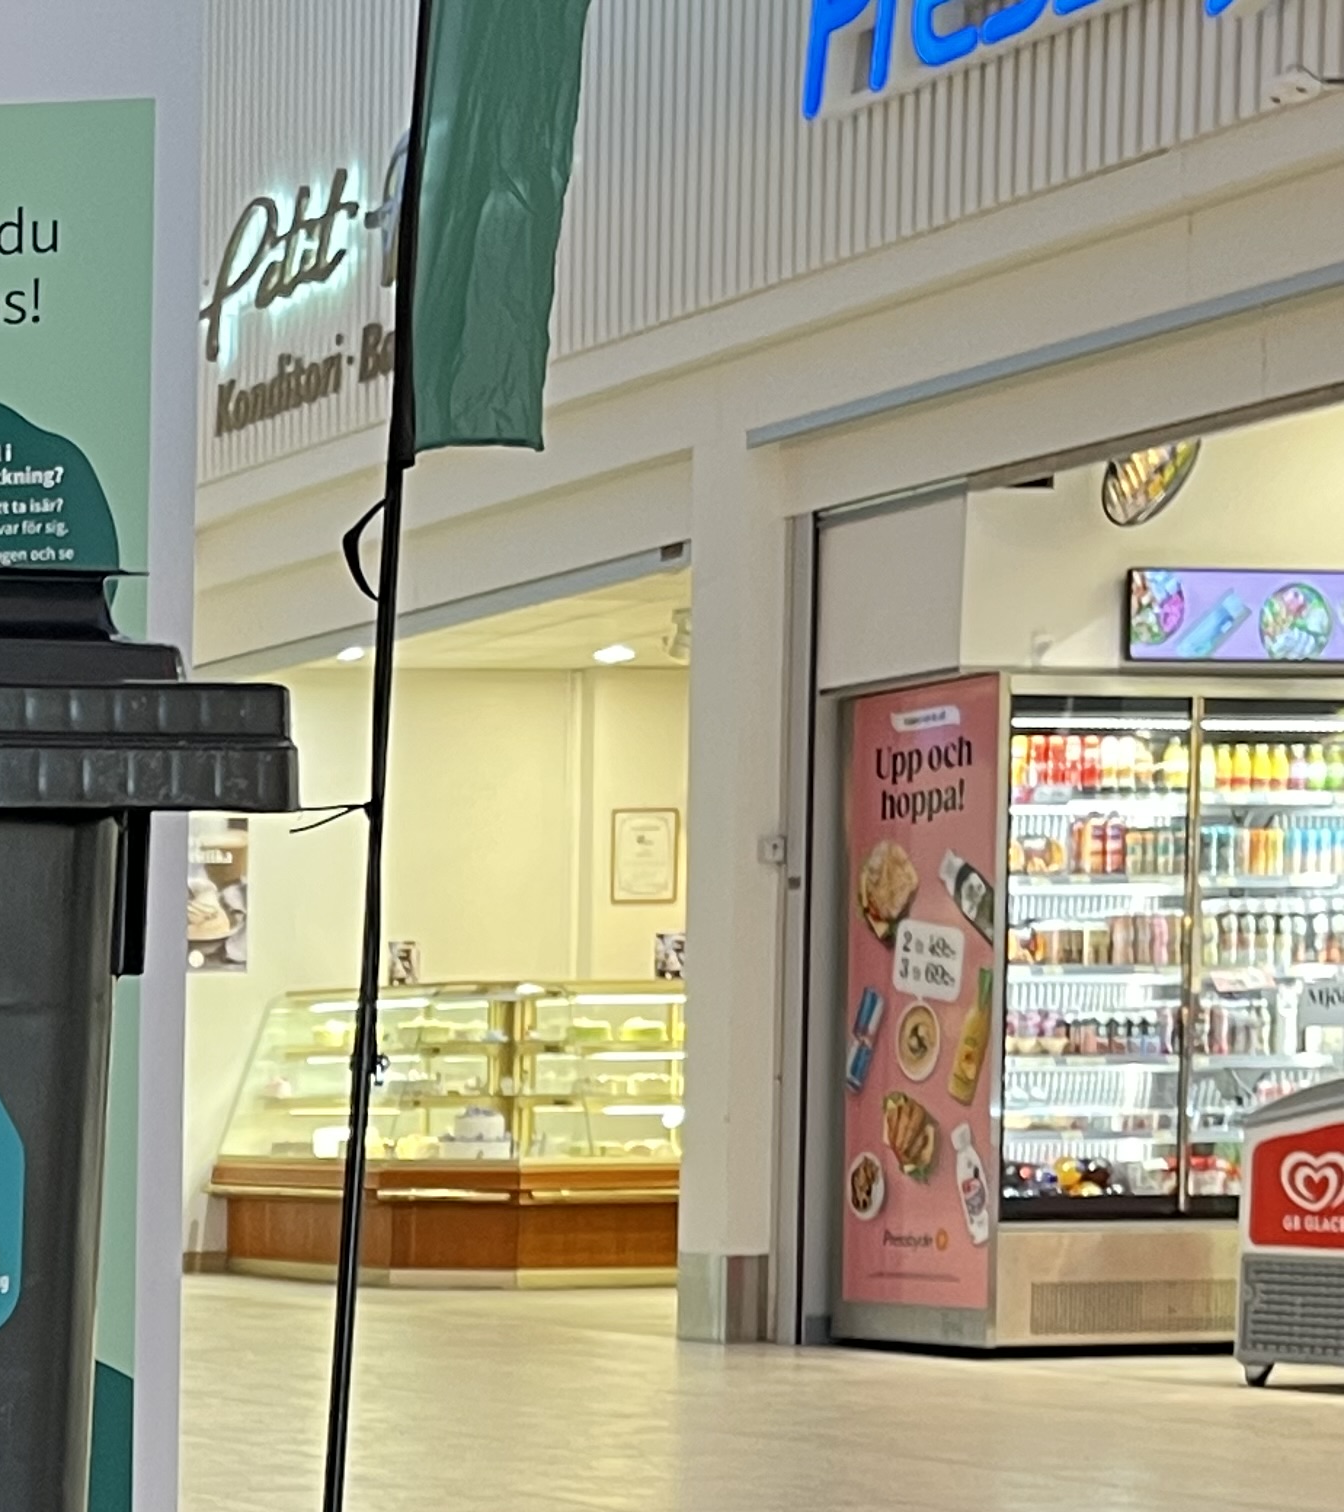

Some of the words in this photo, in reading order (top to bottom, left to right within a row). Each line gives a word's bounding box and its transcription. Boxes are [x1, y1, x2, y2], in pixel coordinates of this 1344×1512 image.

[216, 334, 342, 437] Konditori
[5, 444, 12, 462] i
[12, 500, 27, 514] ta
[30, 498, 64, 514] isär?
[21, 520, 42, 534] för
[45, 520, 69, 537] sig.
[30, 546, 55, 561] och
[59, 548, 74, 561] se
[875, 747, 923, 785] Upp
[927, 736, 972, 772] och
[881, 779, 965, 825] hoppa!
